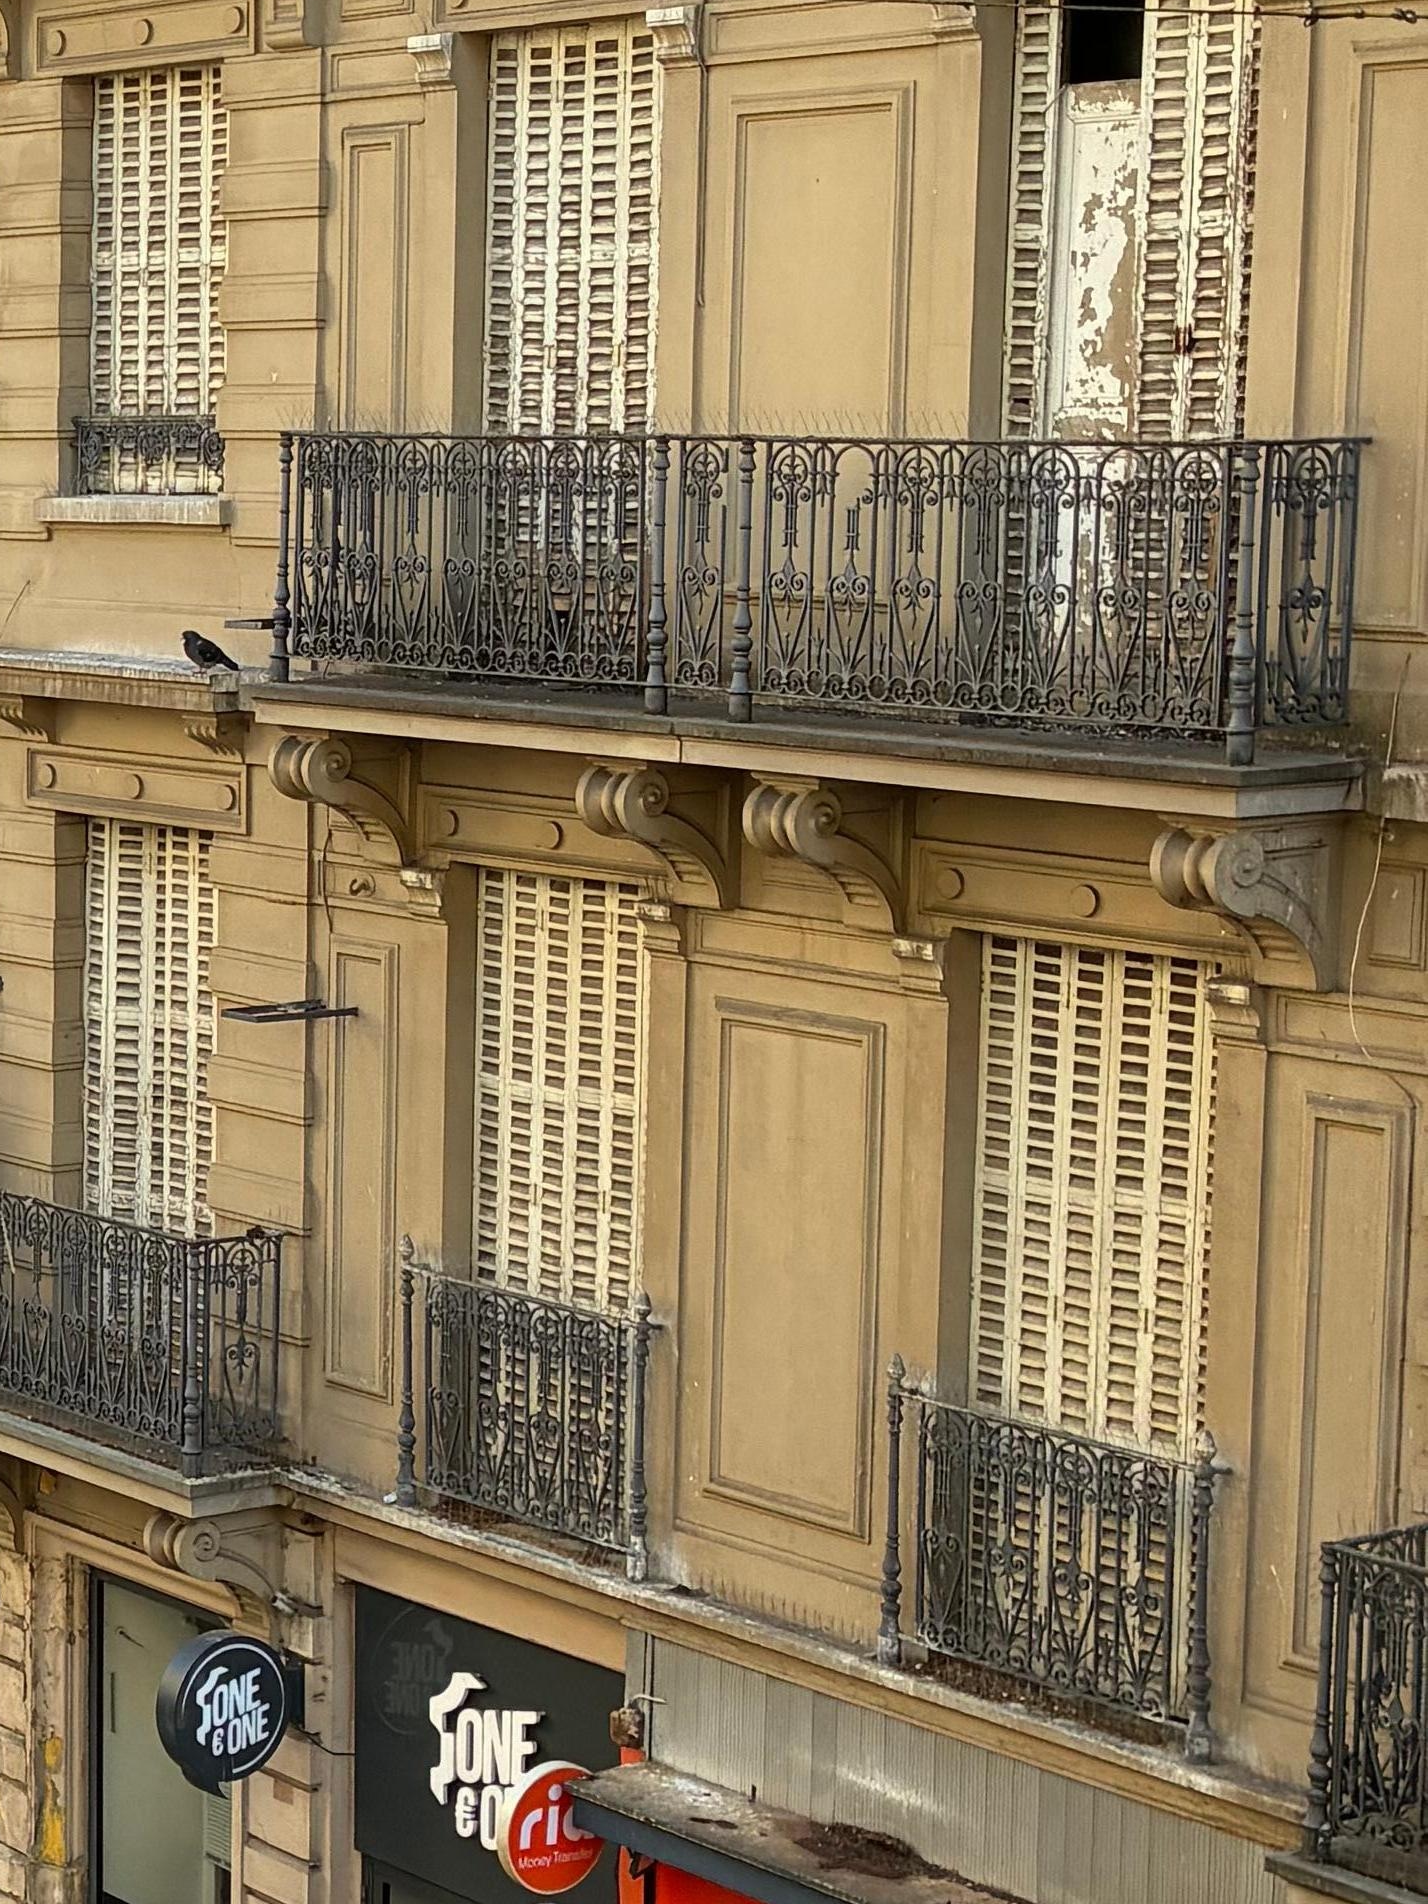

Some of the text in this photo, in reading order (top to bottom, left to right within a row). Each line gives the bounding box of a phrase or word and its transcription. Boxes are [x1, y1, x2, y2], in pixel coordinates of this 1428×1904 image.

[212, 1667, 262, 1727] ONE
[227, 1702, 271, 1755] ONE
[456, 1708, 546, 1786] ONE
[518, 1855, 552, 1869] Money
